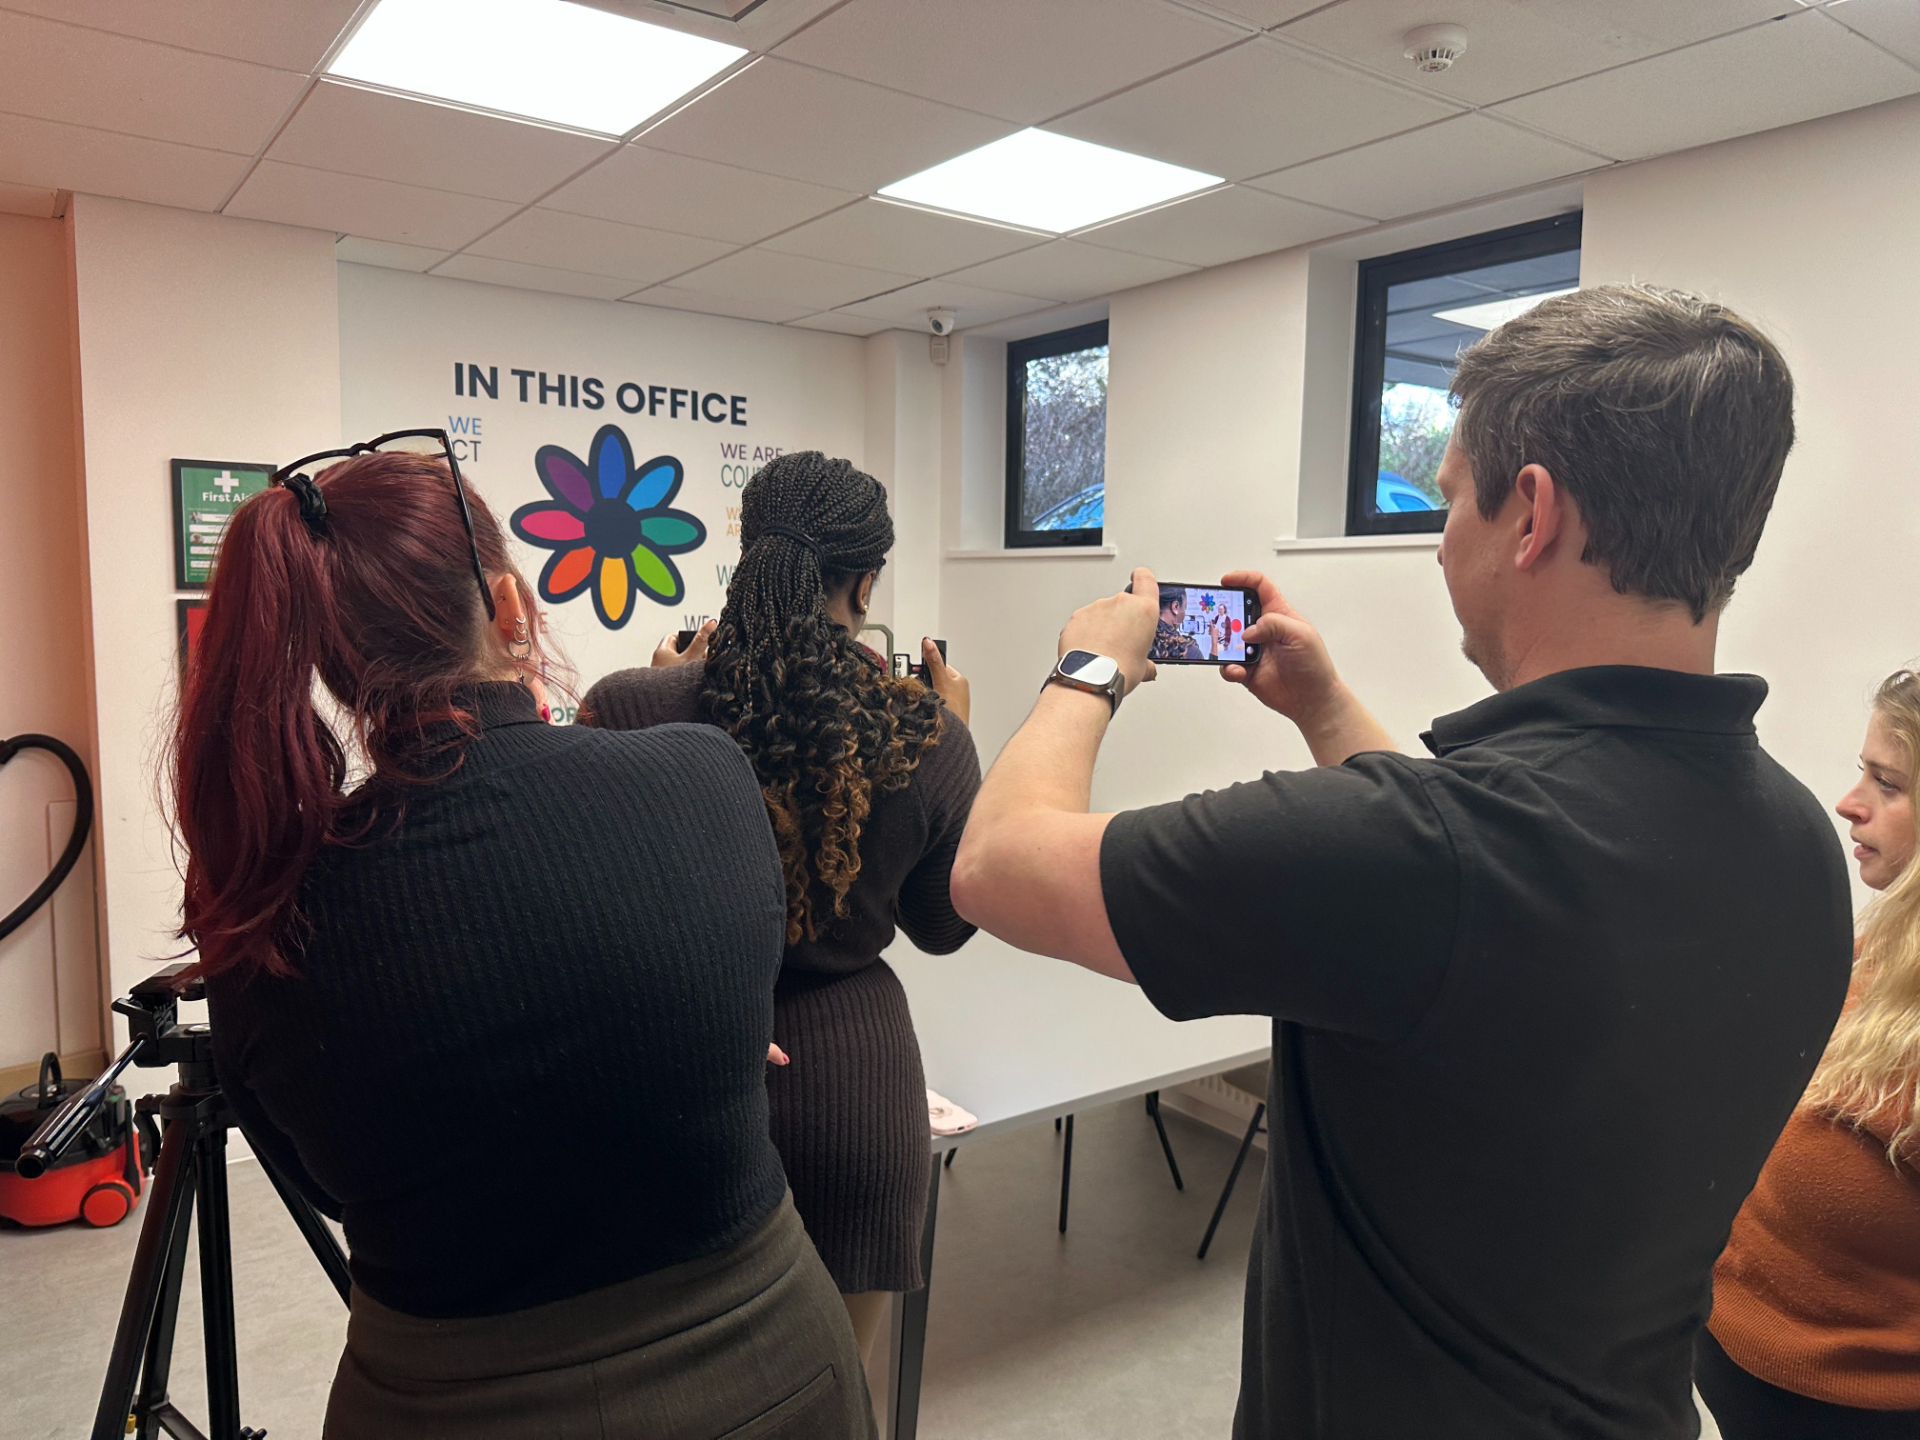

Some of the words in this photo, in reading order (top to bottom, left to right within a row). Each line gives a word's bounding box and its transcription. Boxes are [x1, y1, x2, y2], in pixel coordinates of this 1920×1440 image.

[455, 362, 498, 399] IN
[511, 369, 605, 410] THIS
[616, 382, 747, 426] OFFICE
[448, 415, 482, 435] WE
[452, 439, 481, 462] CT
[720, 442, 747, 461] WE
[202, 491, 230, 502] First
[725, 506, 742, 521] W
